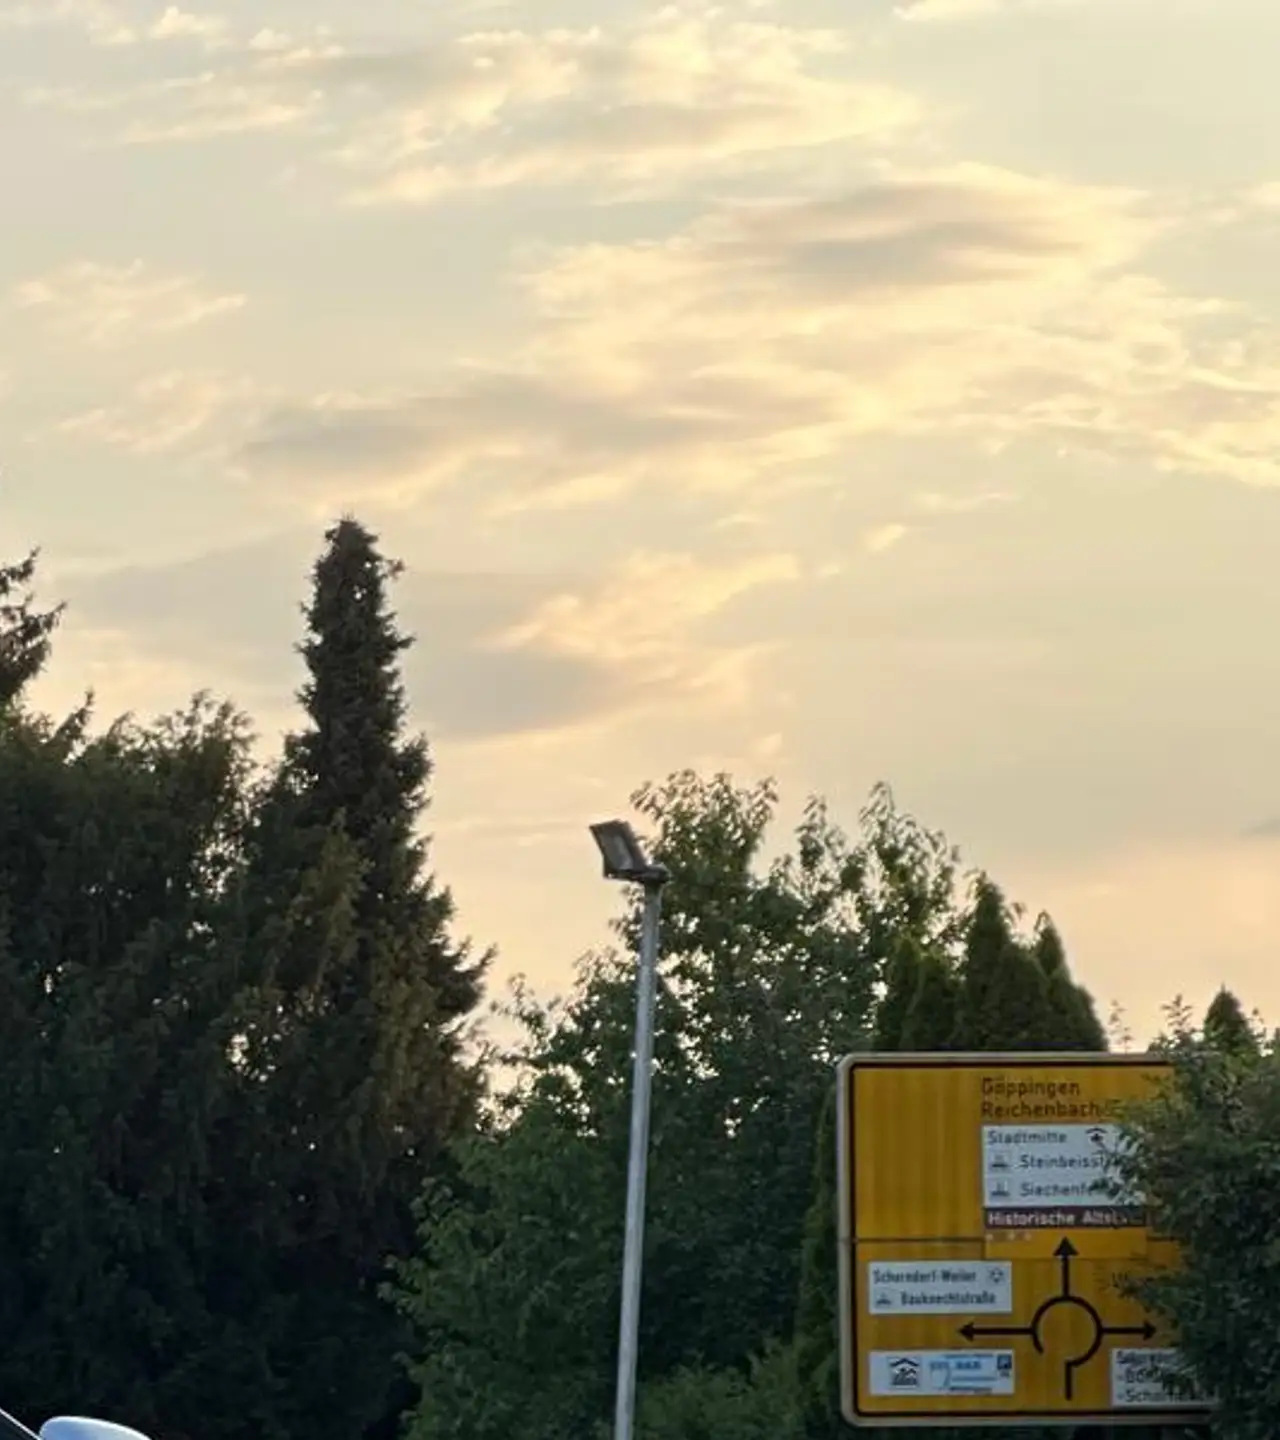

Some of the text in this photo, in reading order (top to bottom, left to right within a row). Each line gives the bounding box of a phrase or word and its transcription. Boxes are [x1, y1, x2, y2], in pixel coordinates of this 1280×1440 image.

[981, 1076, 1081, 1098] Göppingen
[981, 1100, 1100, 1118] Reichenbach
[988, 1130, 1068, 1145] Stadtmitte
[989, 1209, 1076, 1226] Historische
